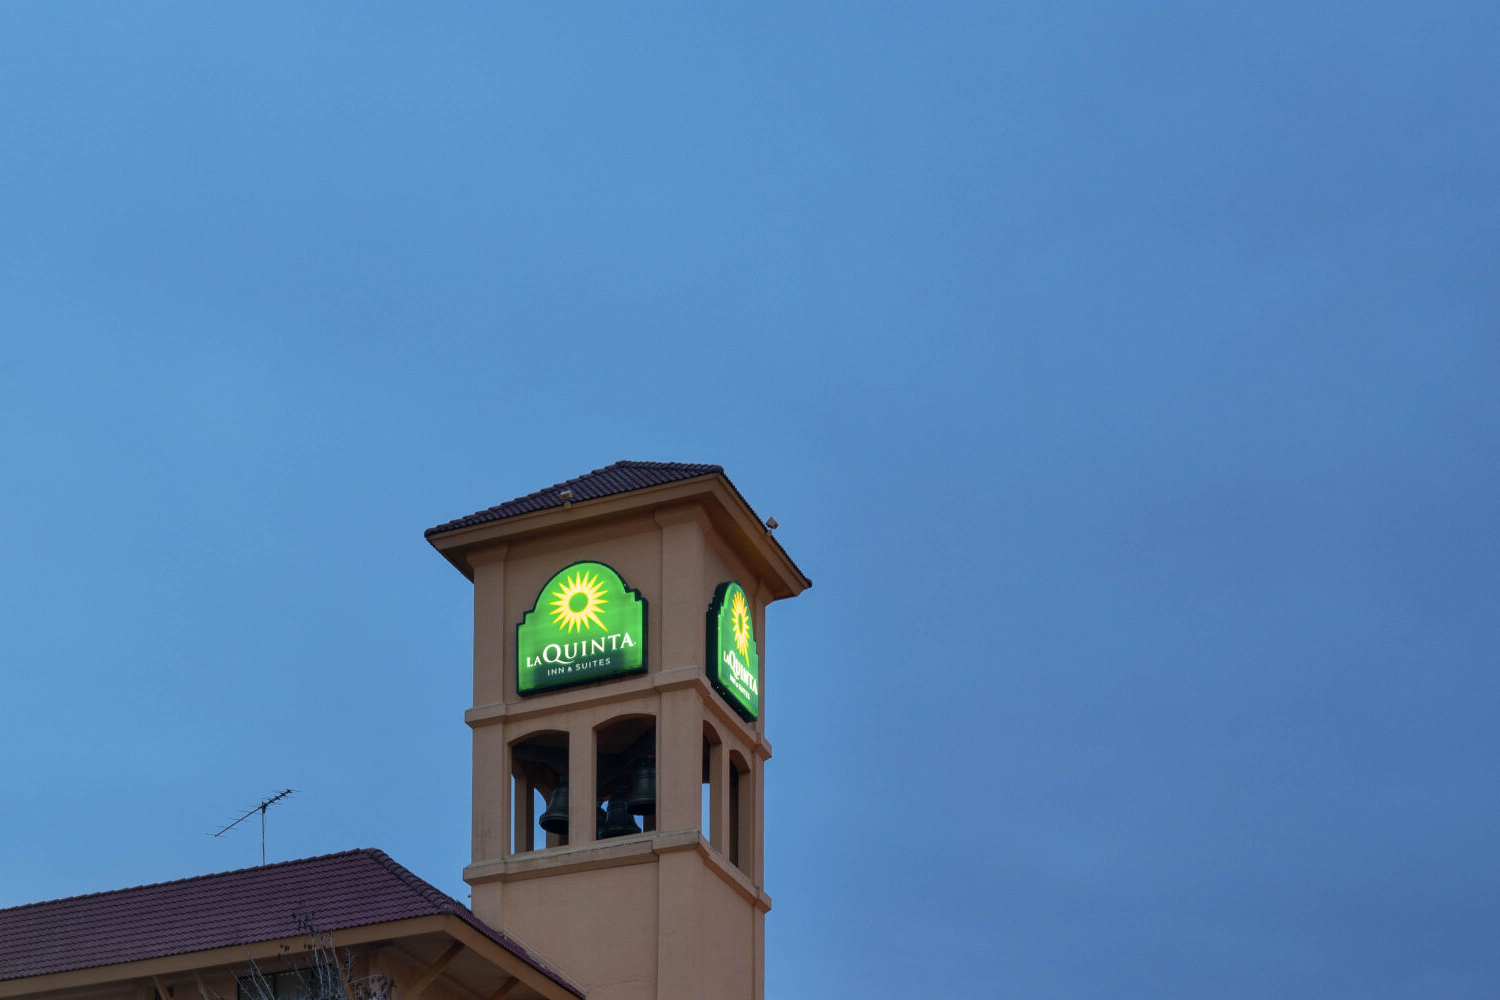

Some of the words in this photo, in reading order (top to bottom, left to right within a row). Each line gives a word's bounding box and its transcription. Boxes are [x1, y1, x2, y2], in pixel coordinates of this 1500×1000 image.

[526, 656, 542, 668] LA
[542, 632, 634, 665] QUINTA
[547, 667, 565, 677] INN
[575, 657, 611, 671] SUITES
